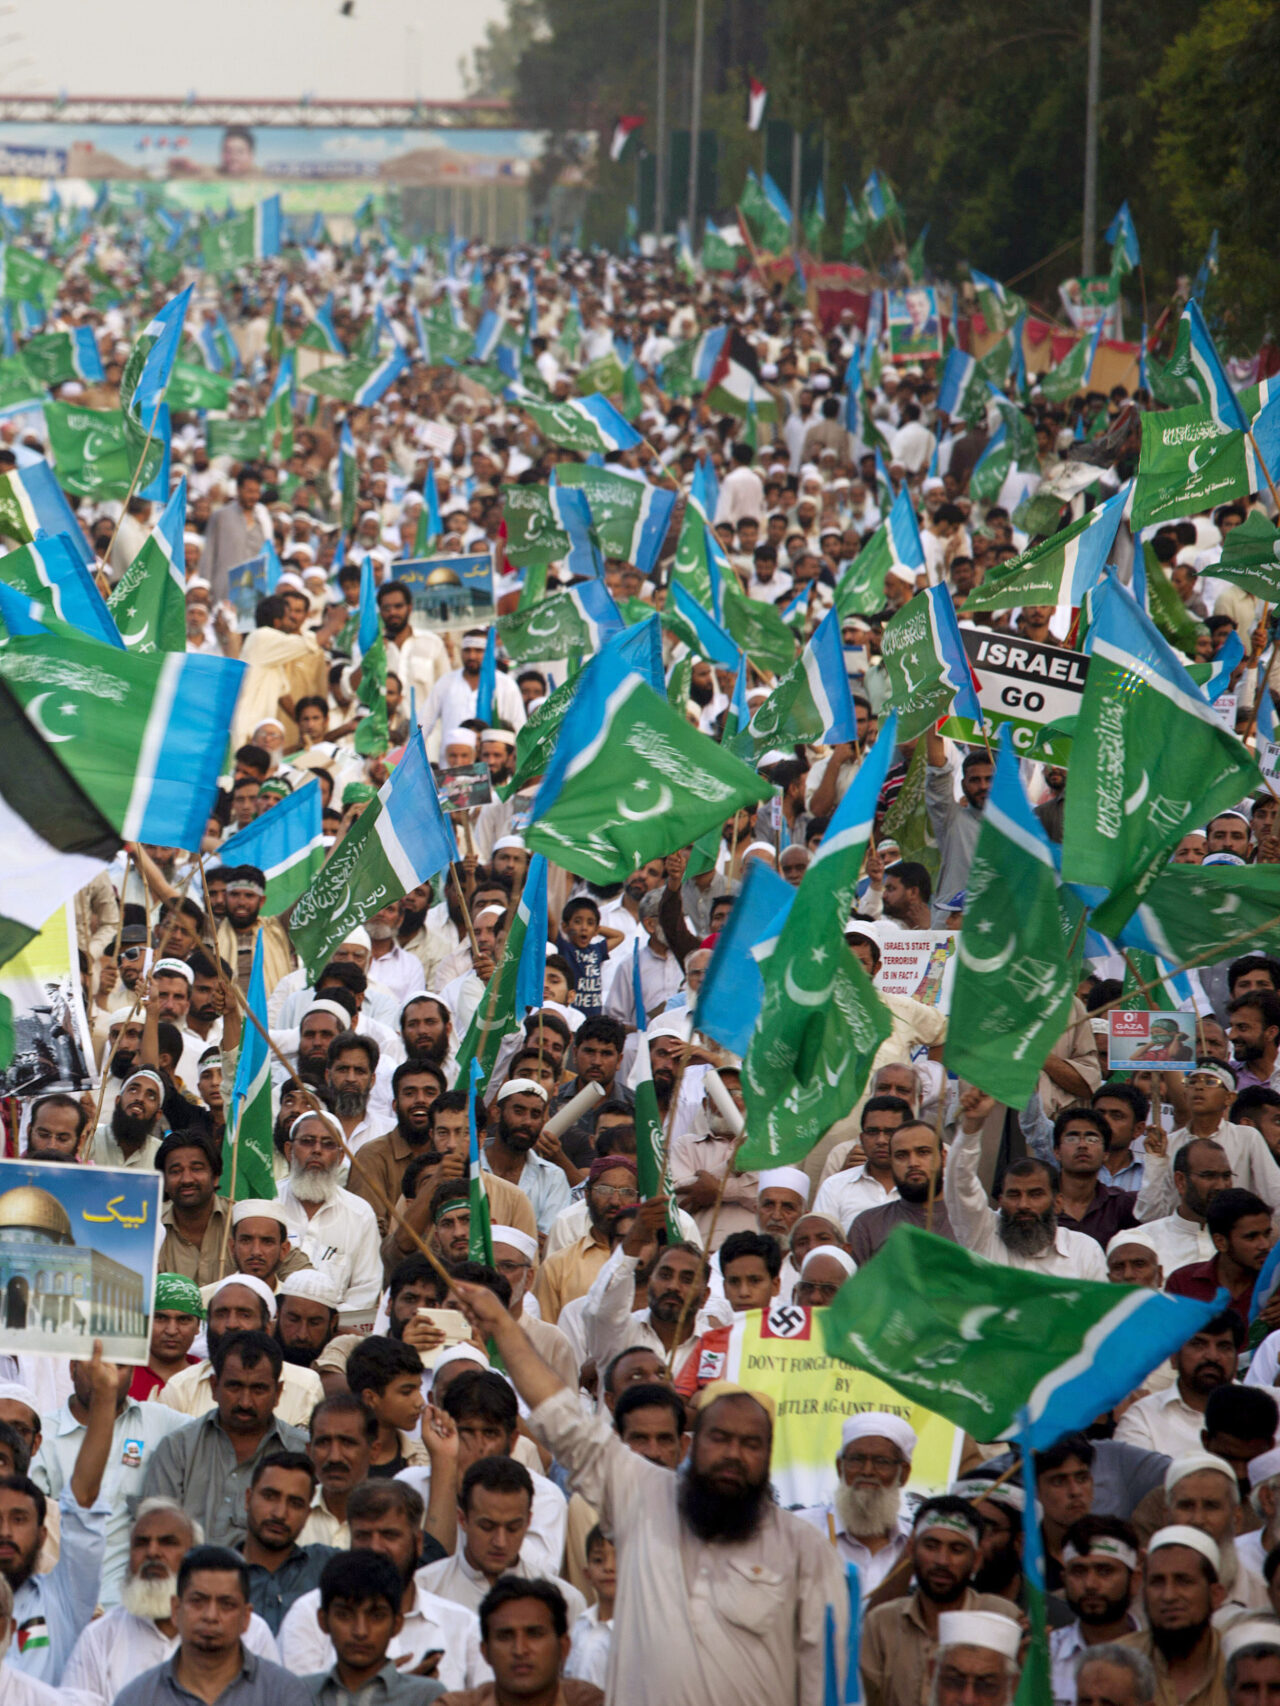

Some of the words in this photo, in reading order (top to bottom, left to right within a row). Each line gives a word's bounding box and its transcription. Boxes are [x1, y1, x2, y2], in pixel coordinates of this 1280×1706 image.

[976, 640, 1086, 686] ISRAEL
[1001, 686, 1045, 712] GO
[883, 956, 918, 965] TERRORISM
[1115, 1023, 1144, 1031] GAZA
[790, 1356, 837, 1372] FORGET
[834, 1377, 852, 1393] BY
[822, 1399, 875, 1416] AGAINST
